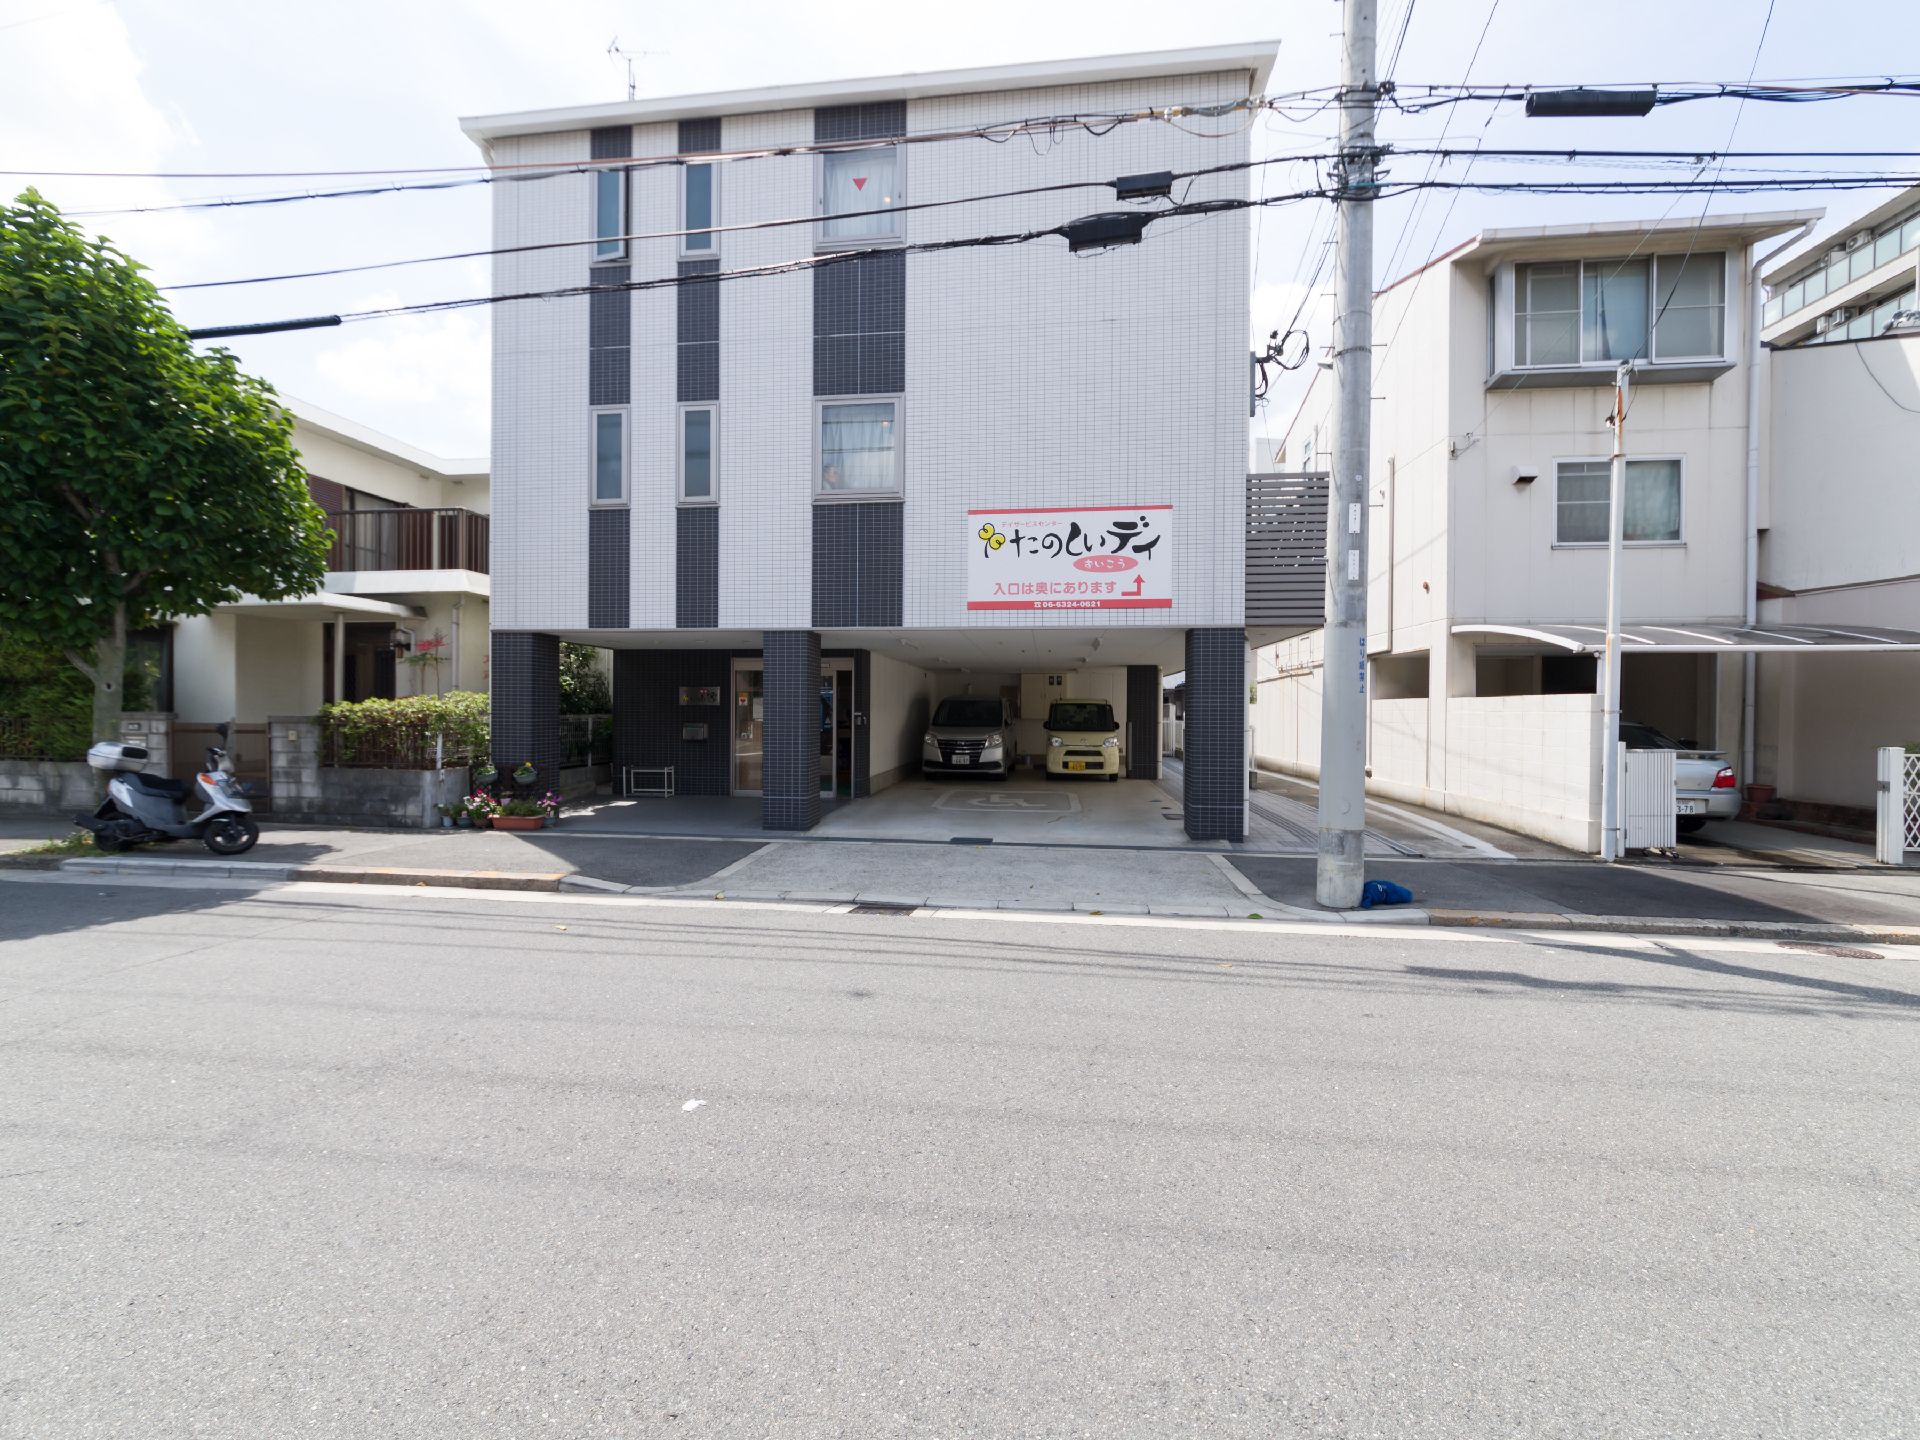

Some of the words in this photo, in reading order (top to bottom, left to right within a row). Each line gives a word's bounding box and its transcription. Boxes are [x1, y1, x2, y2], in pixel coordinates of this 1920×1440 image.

[993, 581, 1117, 595] 入口は奥にあります
